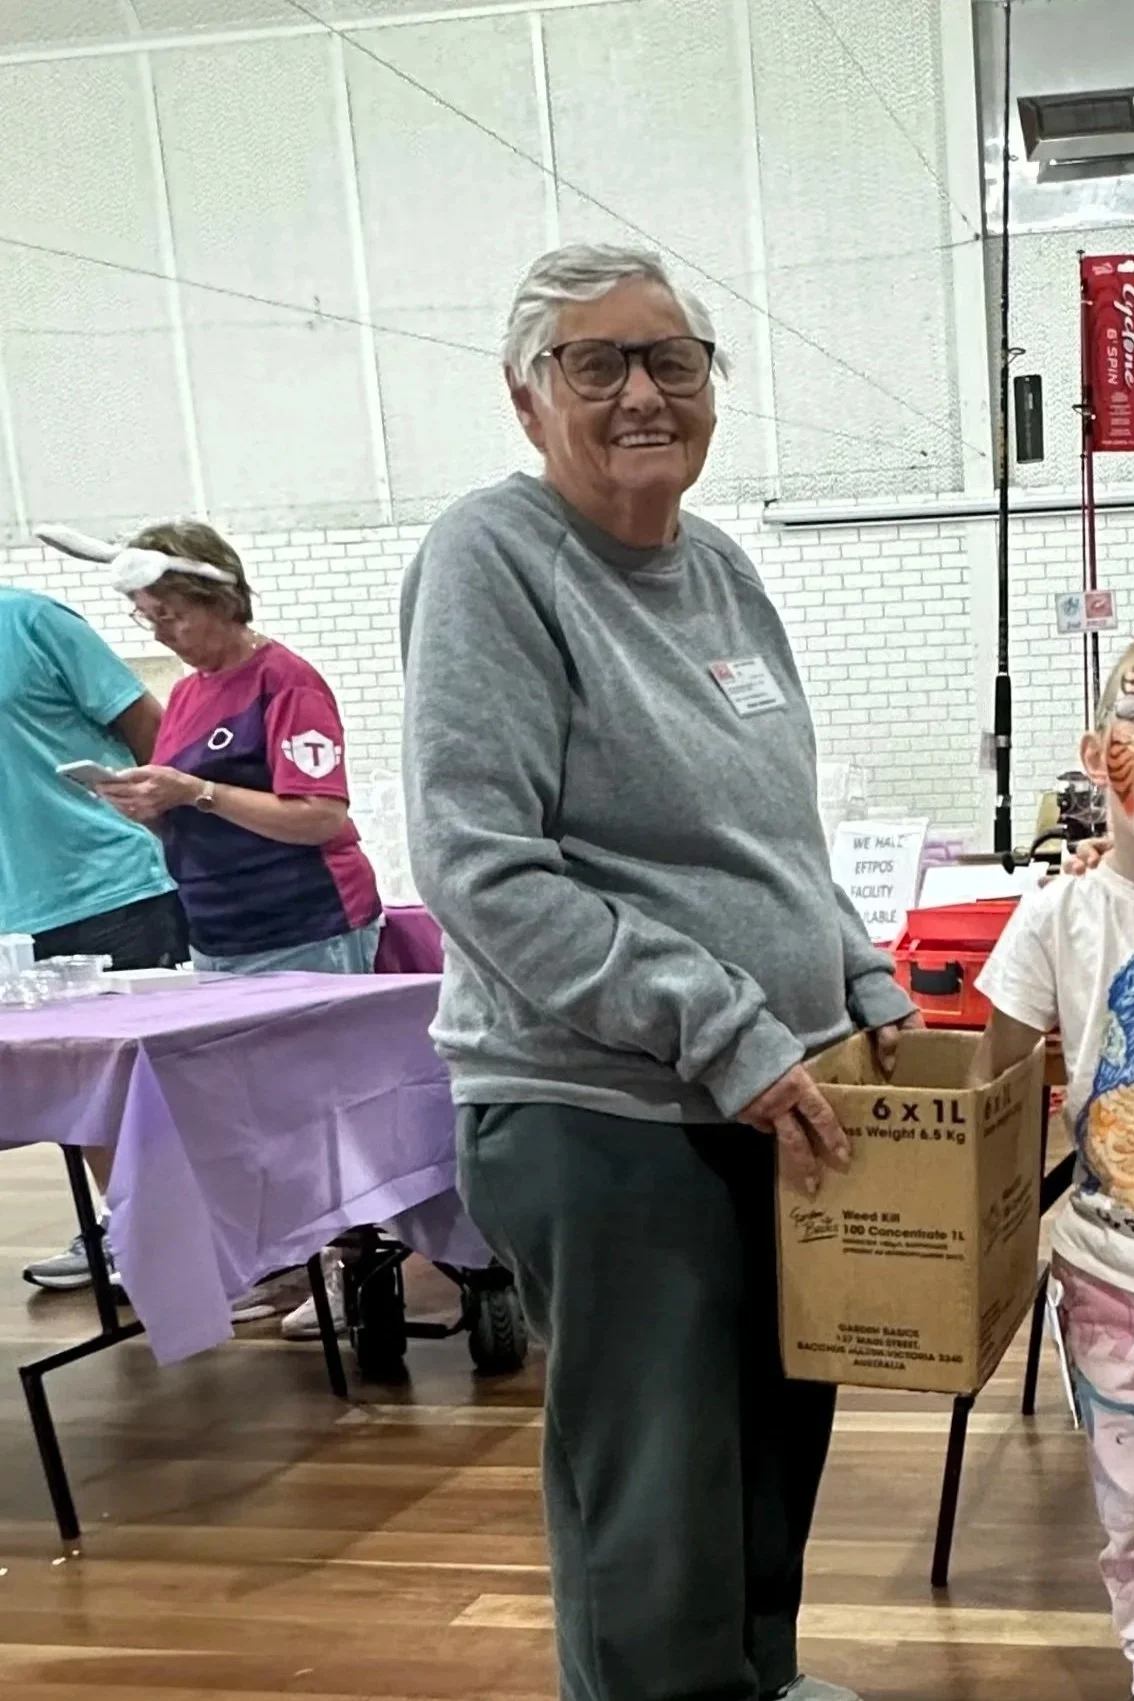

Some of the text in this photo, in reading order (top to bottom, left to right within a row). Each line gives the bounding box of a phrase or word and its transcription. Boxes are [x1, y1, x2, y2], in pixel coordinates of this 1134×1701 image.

[1106, 347, 1119, 386] SPIN
[303, 742, 325, 767] T
[853, 836, 871, 850] WE
[854, 860, 894, 875] EFTPOS
[850, 884, 894, 899] FACILITY
[872, 1096, 891, 1121] 6
[902, 1102, 920, 1122] x
[932, 1098, 966, 1124] 1L
[866, 1125, 916, 1142] Weight
[919, 1128, 942, 1141] 6.5
[946, 1129, 966, 1145] Kg
[842, 1209, 901, 1223] Weed Kill
[842, 1224, 866, 1235] 100
[868, 1225, 948, 1241] Concentrate
[837, 1323, 920, 1339] GARDEN BASICS
